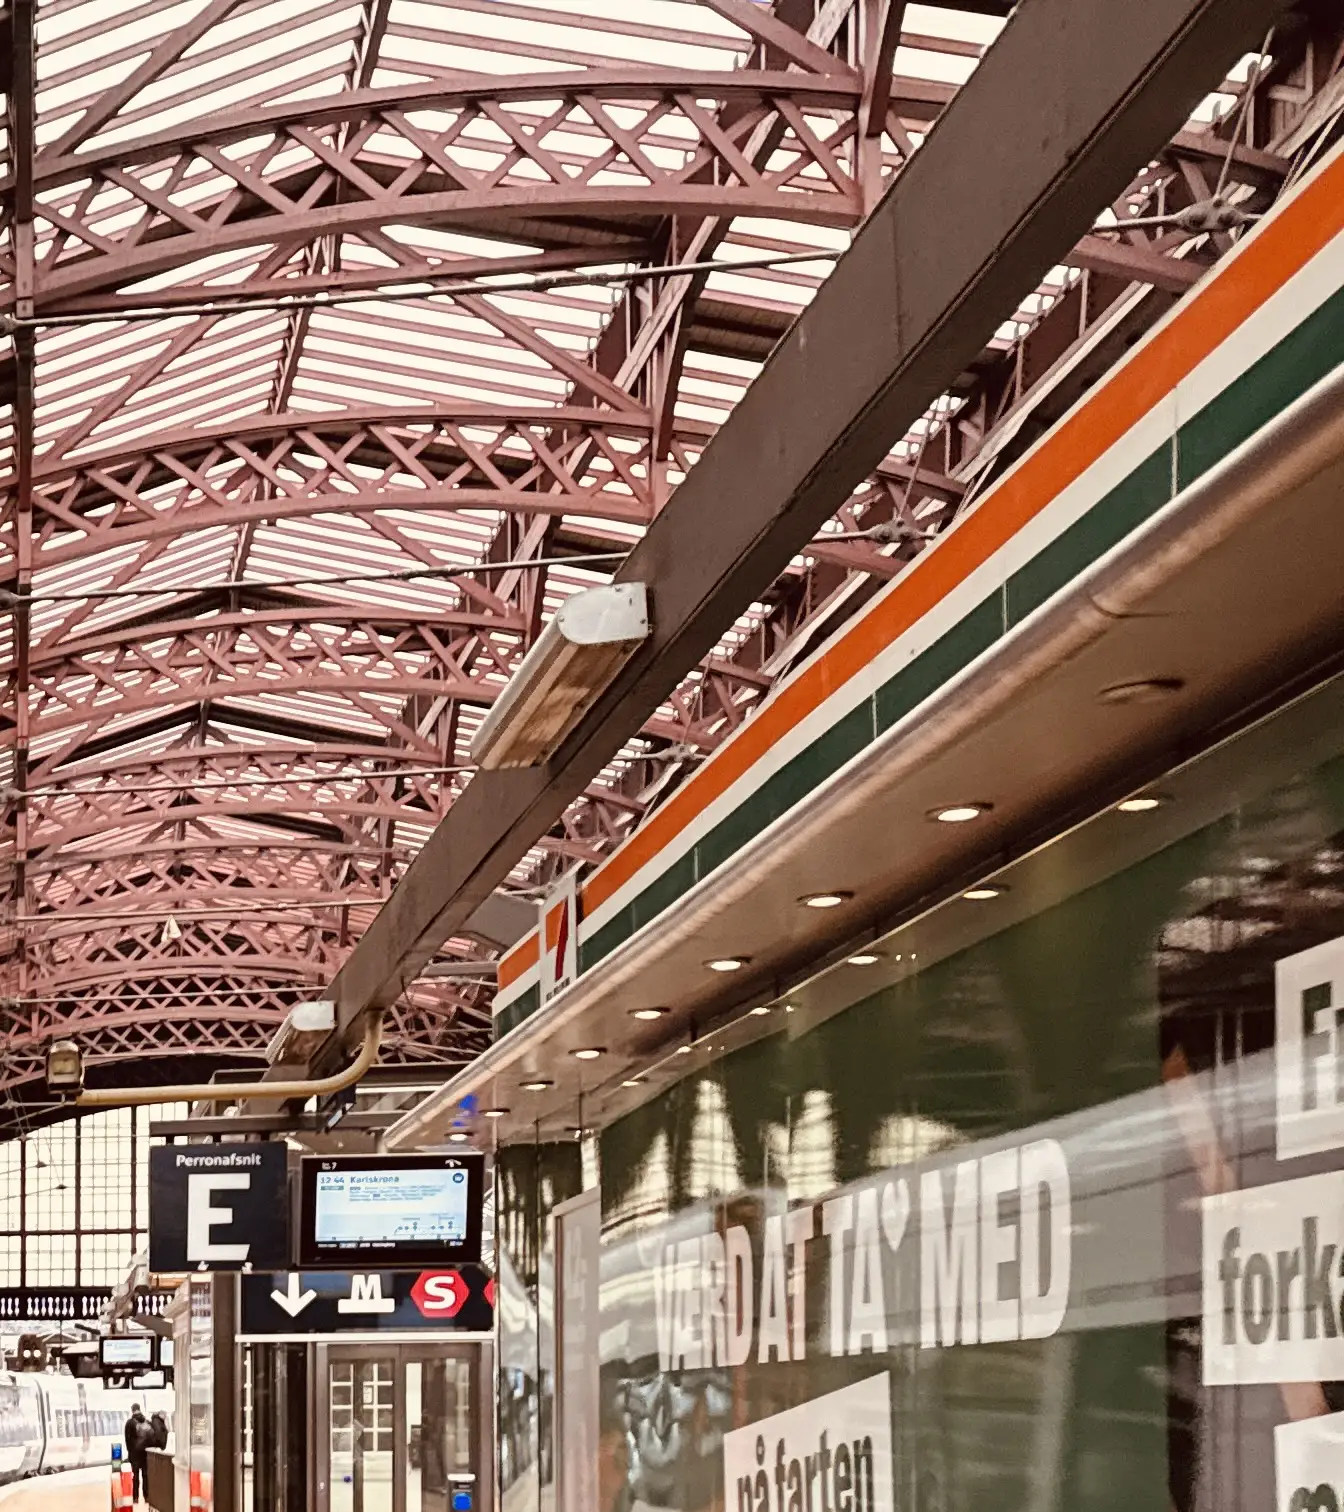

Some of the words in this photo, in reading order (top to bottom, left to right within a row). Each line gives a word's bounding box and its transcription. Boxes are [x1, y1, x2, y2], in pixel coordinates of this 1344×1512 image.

[1301, 980, 1344, 1112] F
[175, 1152, 262, 1168] Perronafsnit
[186, 1172, 251, 1262] E
[758, 1205, 814, 1365] AT
[920, 1138, 1072, 1350] MED
